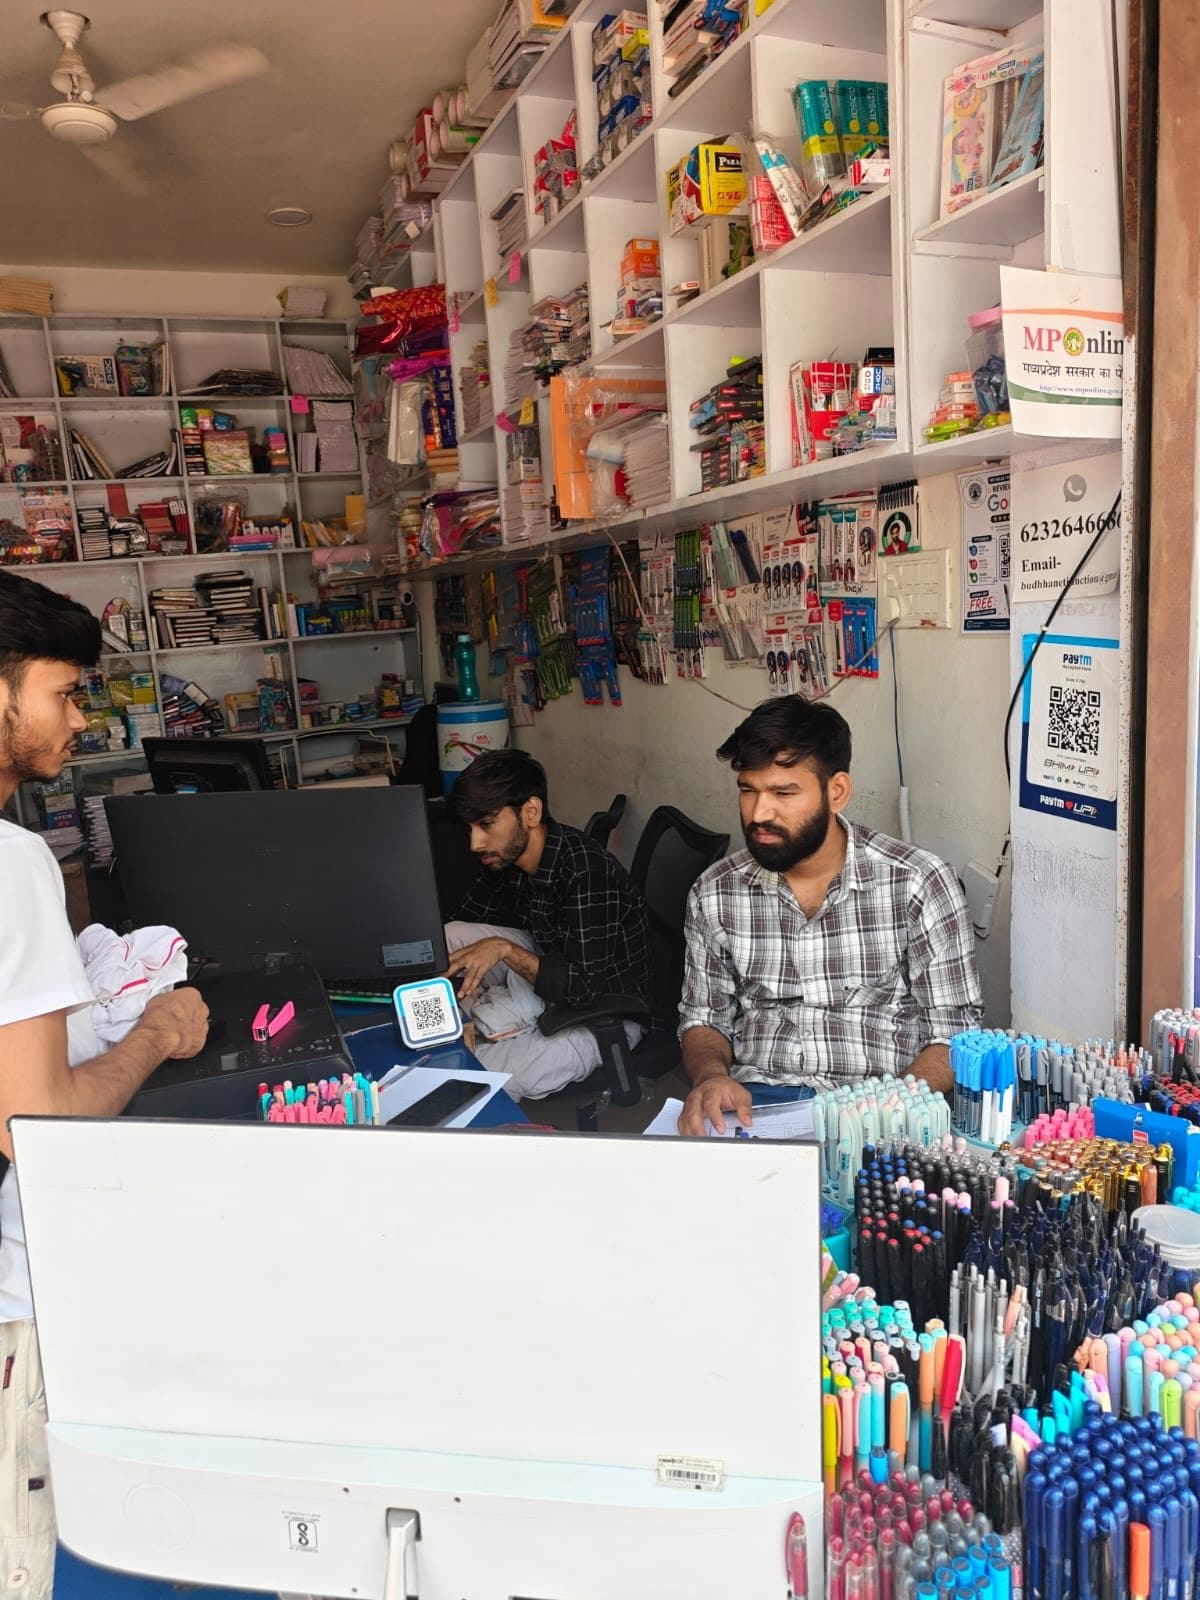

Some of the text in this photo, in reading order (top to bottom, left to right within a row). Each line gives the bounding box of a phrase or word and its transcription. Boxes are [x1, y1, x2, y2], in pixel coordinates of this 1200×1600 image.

[1065, 366, 1096, 378] सरकार
[1099, 368, 1111, 379] का
[1022, 556, 1062, 572] Email-
[969, 597, 993, 609] FREE
